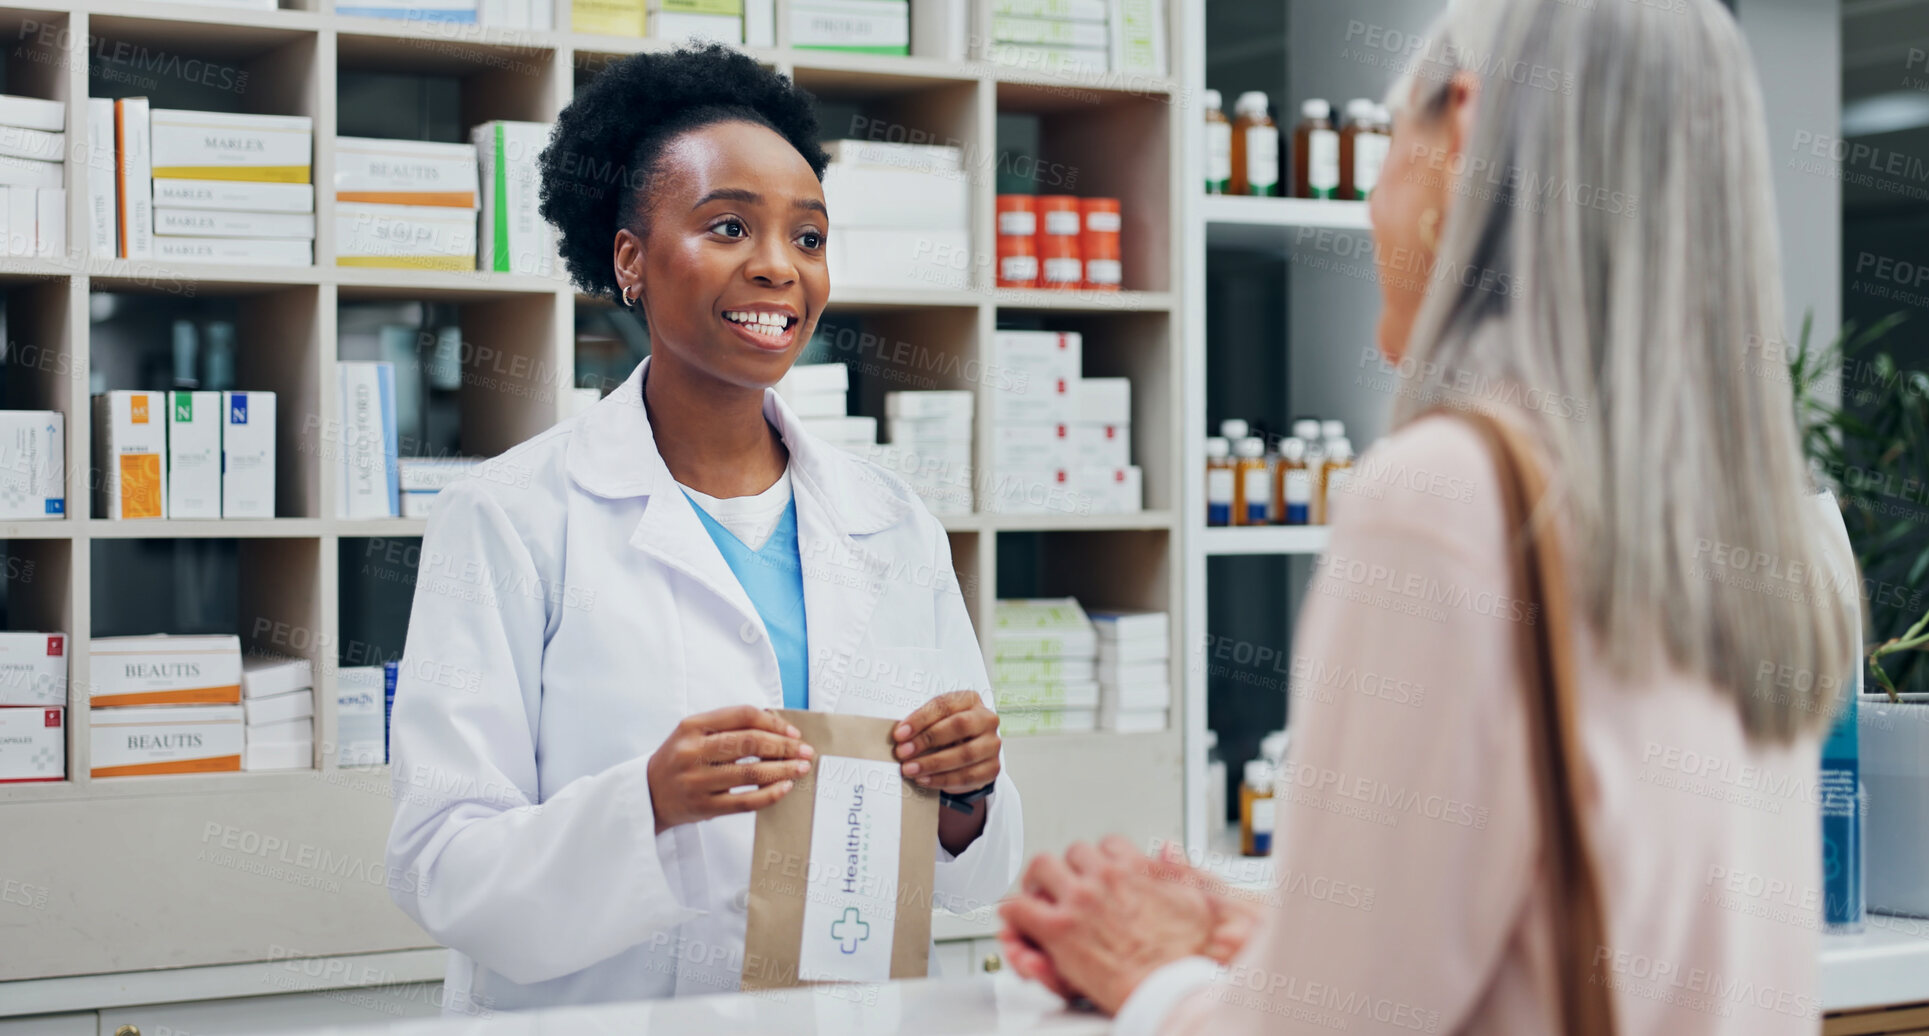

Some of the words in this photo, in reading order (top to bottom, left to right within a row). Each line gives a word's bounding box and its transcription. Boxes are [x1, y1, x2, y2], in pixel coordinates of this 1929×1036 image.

[204, 136, 265, 151] MARLEX
[125, 663, 200, 678] BEAUTIS
[127, 734, 203, 750] BEAUTIS
[842, 784, 866, 894] HealthPlus
